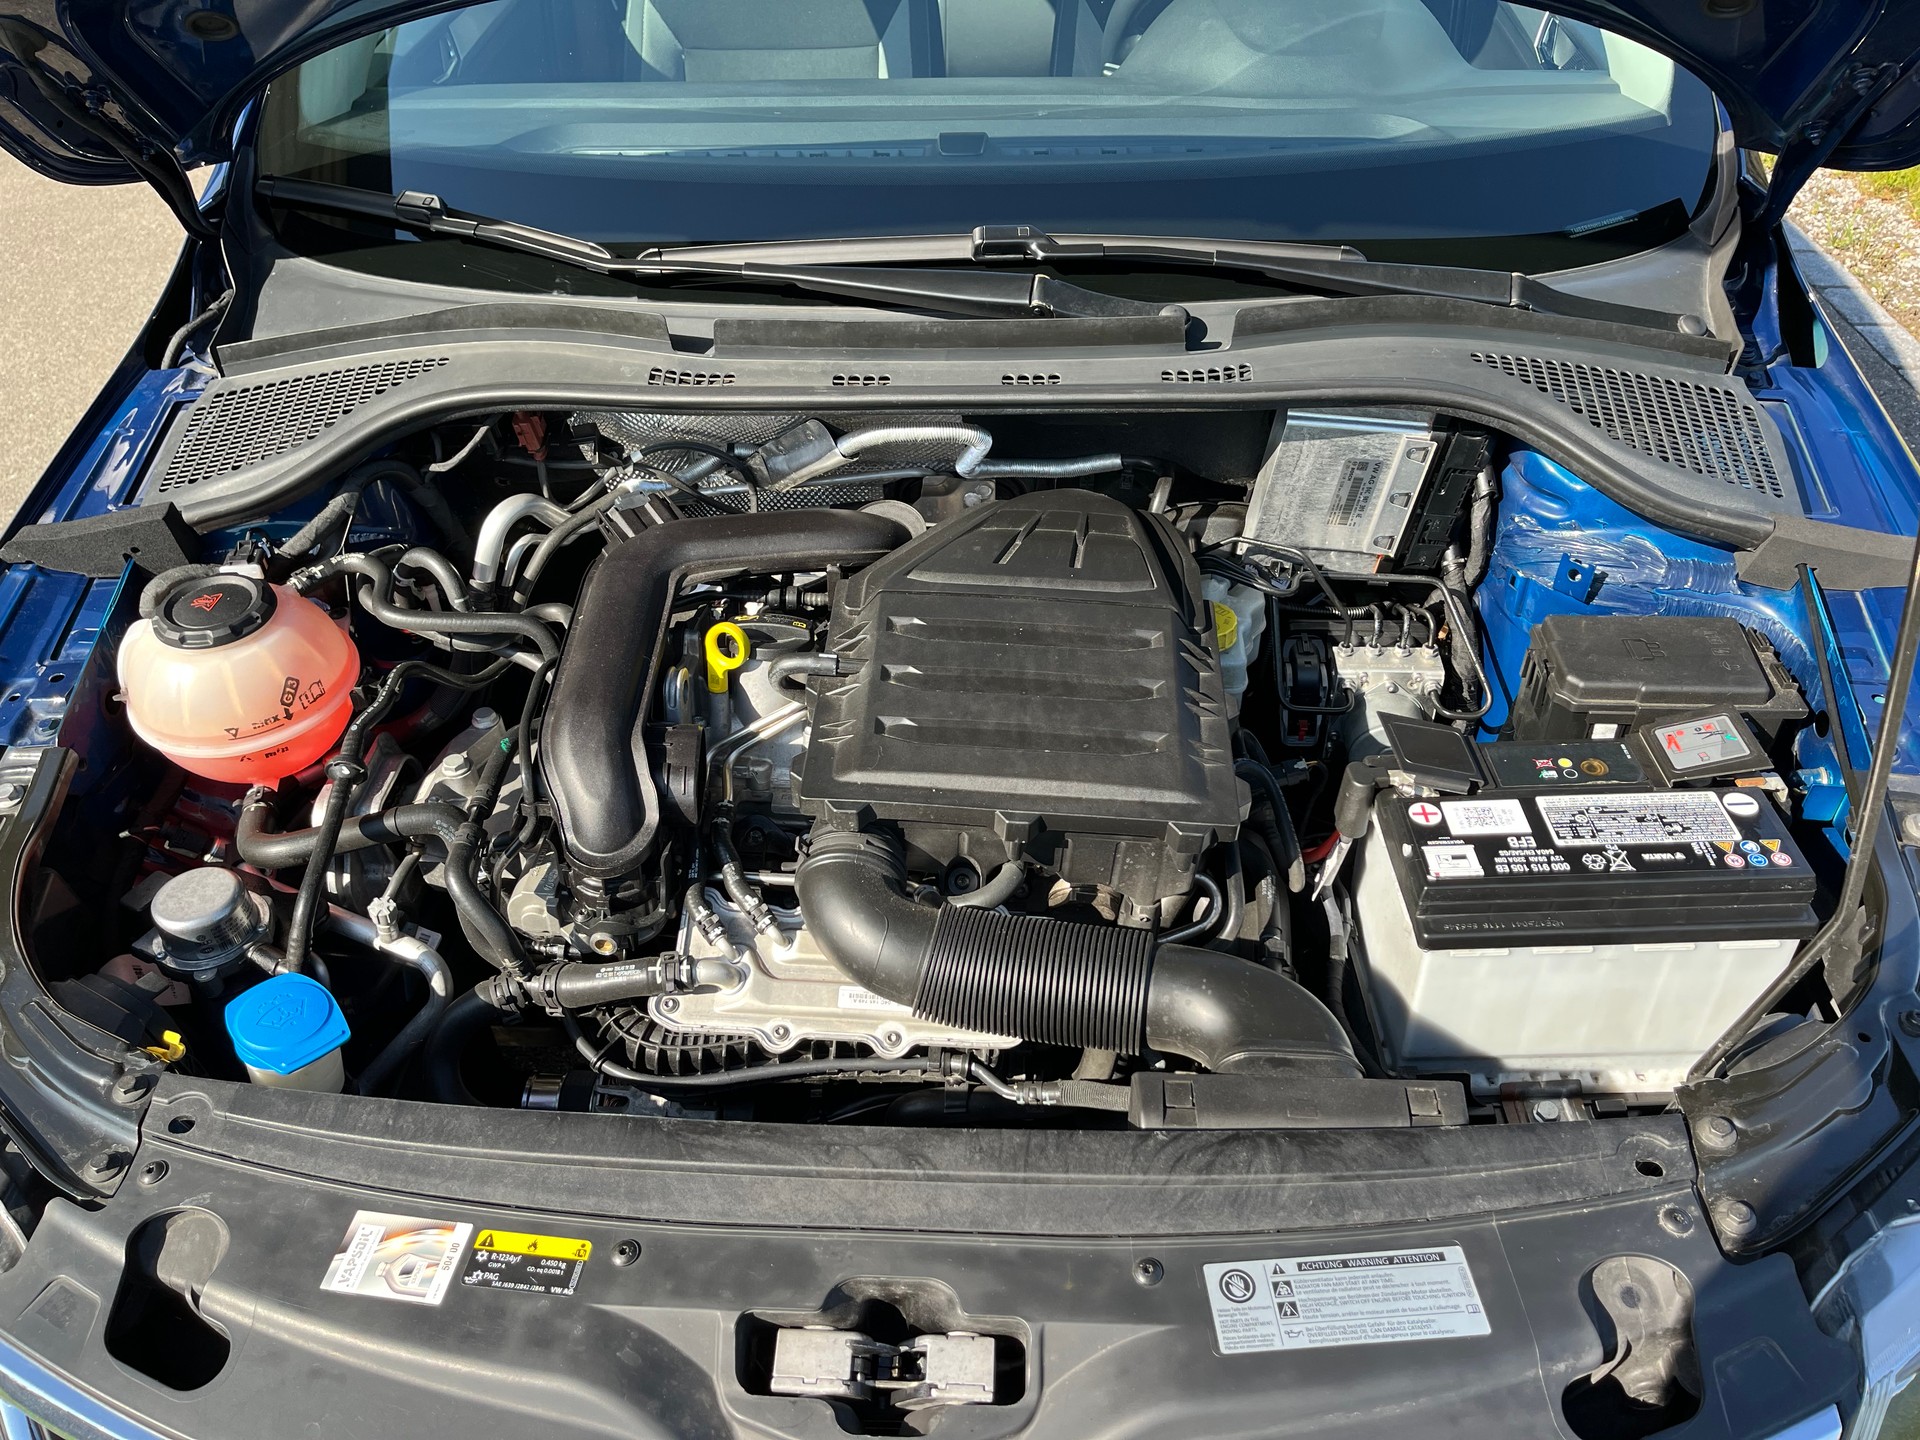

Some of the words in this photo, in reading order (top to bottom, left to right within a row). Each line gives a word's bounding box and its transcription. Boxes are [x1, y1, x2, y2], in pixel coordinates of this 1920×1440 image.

[1368, 475, 1376, 485] AG
[283, 680, 298, 703] G13
[1506, 836, 1537, 848] EFB
[1495, 864, 1510, 873] EB
[1510, 863, 1530, 872] 105
[1531, 863, 1550, 872] 915
[1551, 862, 1571, 871] 000
[442, 1256, 455, 1271] 504
[450, 1242, 460, 1253] 00
[491, 1253, 522, 1263] R-1234yf
[1300, 1260, 1342, 1270] ACHTUNG
[1347, 1257, 1389, 1266] WARNING
[1392, 1253, 1440, 1263] ATTENTION
[541, 1259, 558, 1267] 0.450
[558, 1260, 567, 1269] kg
[483, 1272, 500, 1280] PAG
[550, 1286, 563, 1294] VW
[563, 1287, 574, 1295] AG
